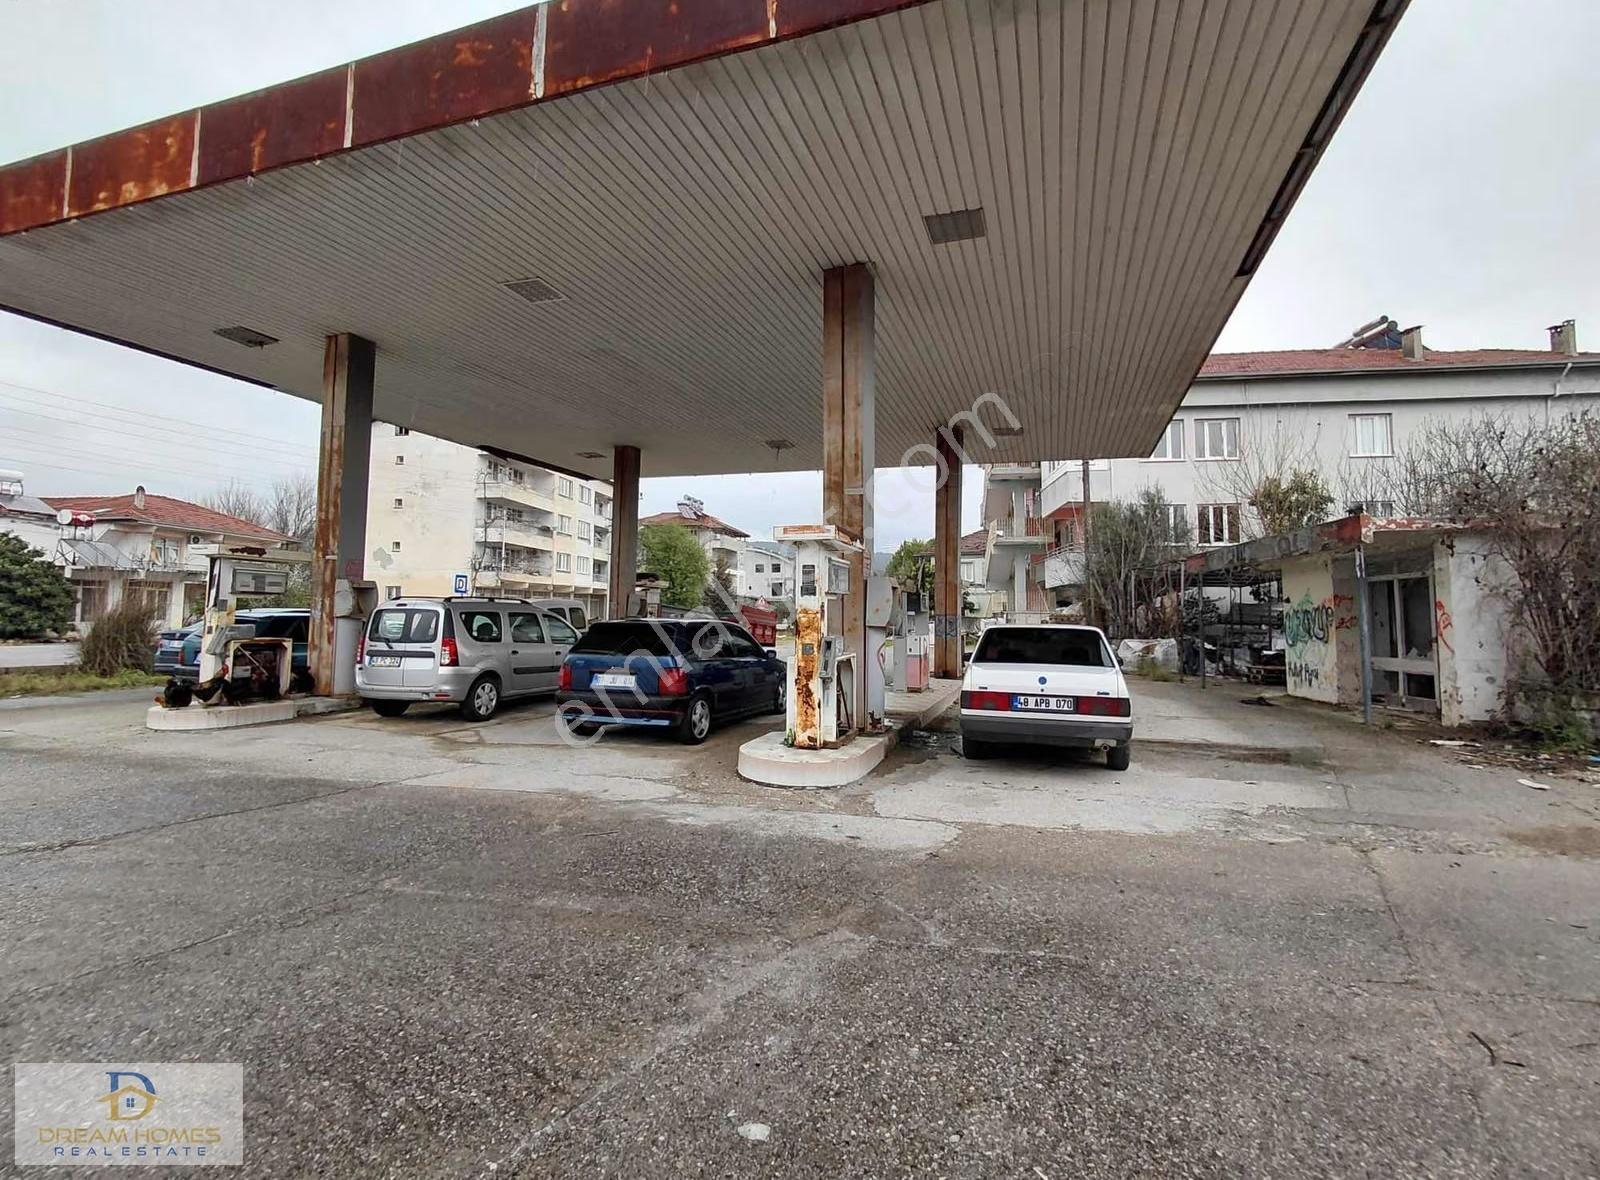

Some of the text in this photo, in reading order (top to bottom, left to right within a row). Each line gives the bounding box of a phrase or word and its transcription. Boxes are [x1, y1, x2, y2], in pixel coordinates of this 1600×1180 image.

[1017, 697, 1072, 709] 48 APB 070
